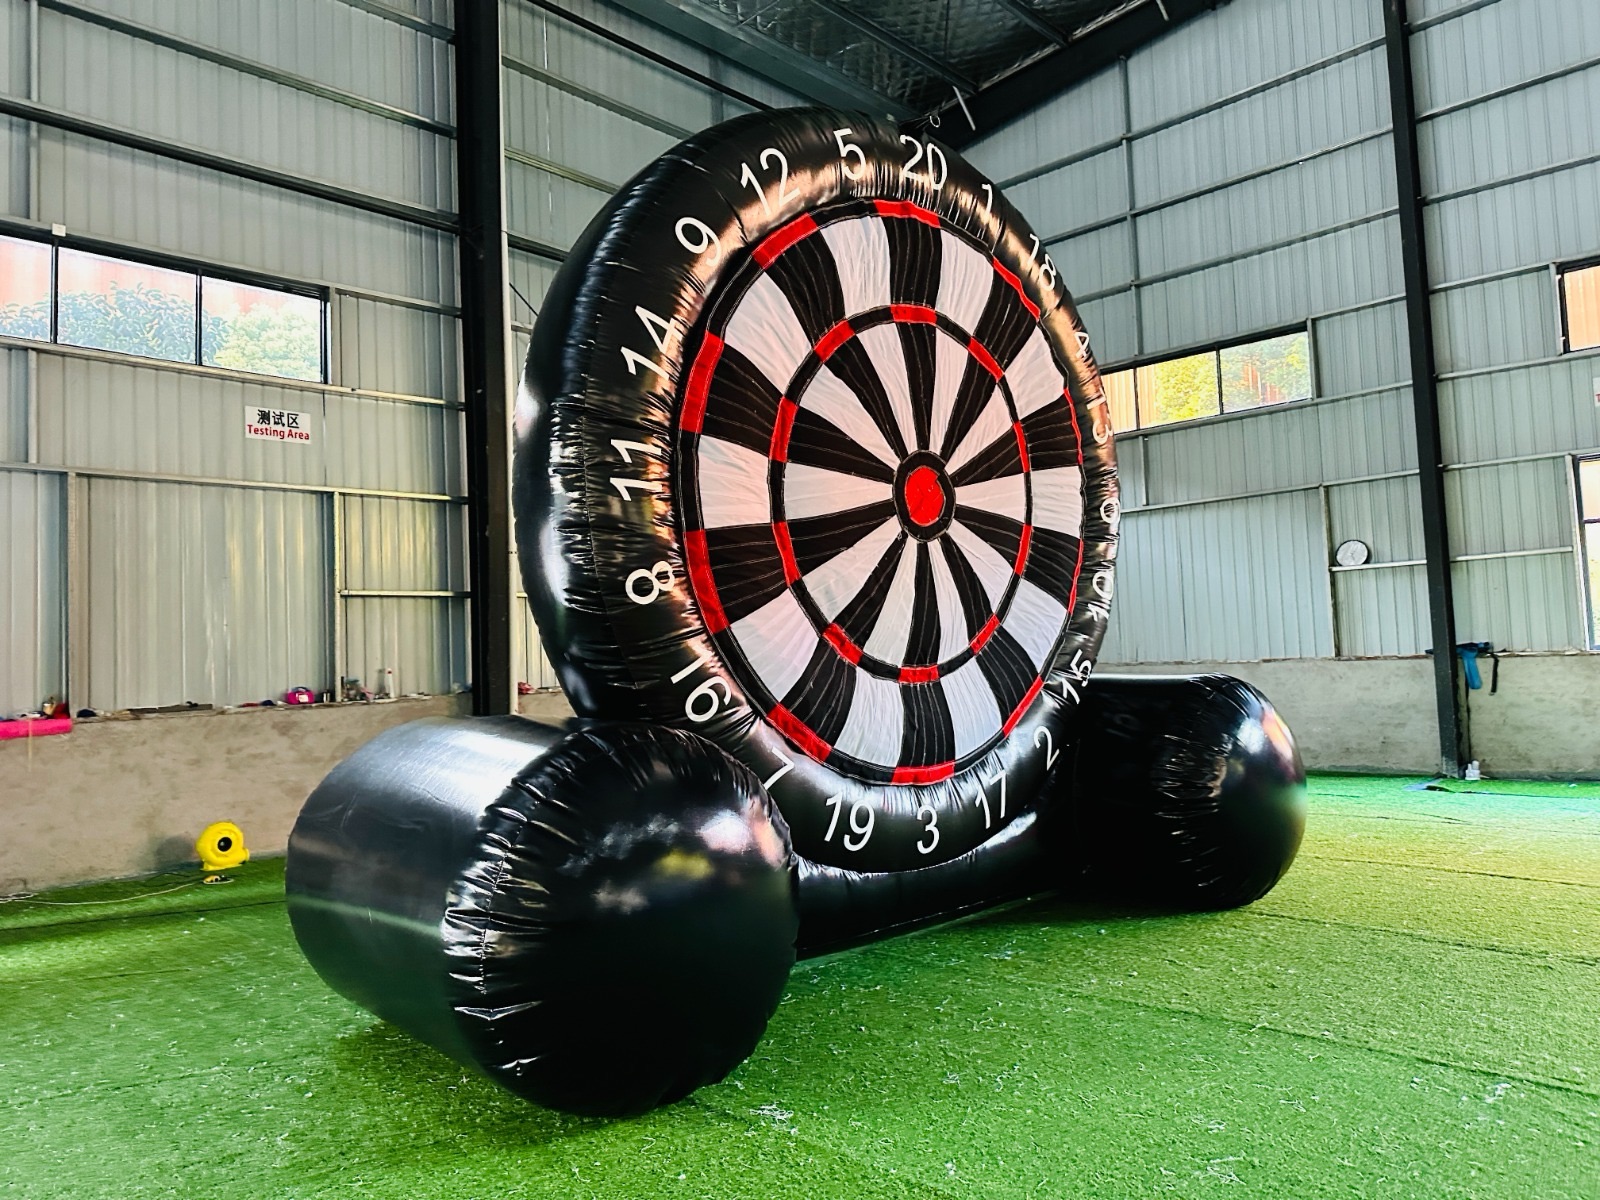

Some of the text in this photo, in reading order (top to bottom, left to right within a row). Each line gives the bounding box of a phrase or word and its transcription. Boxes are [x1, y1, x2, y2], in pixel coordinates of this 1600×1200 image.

[833, 128, 866, 180] 5
[900, 135, 948, 190] 20
[740, 148, 802, 216] 12
[675, 217, 721, 266] 9
[1027, 233, 1056, 291] 18
[621, 306, 685, 380] 14
[1074, 331, 1090, 359] 4
[247, 424, 310, 441] Testing Area
[257, 409, 299, 429] 测试区
[1086, 387, 1114, 444] 13
[610, 439, 662, 501] 11
[625, 561, 675, 605] 8
[670, 650, 732, 722] 16
[1061, 649, 1092, 705] 15
[764, 747, 795, 790] 7
[1034, 726, 1060, 771] 2
[824, 793, 875, 851] 19
[976, 769, 1007, 829] 17
[917, 805, 940, 854] 3
